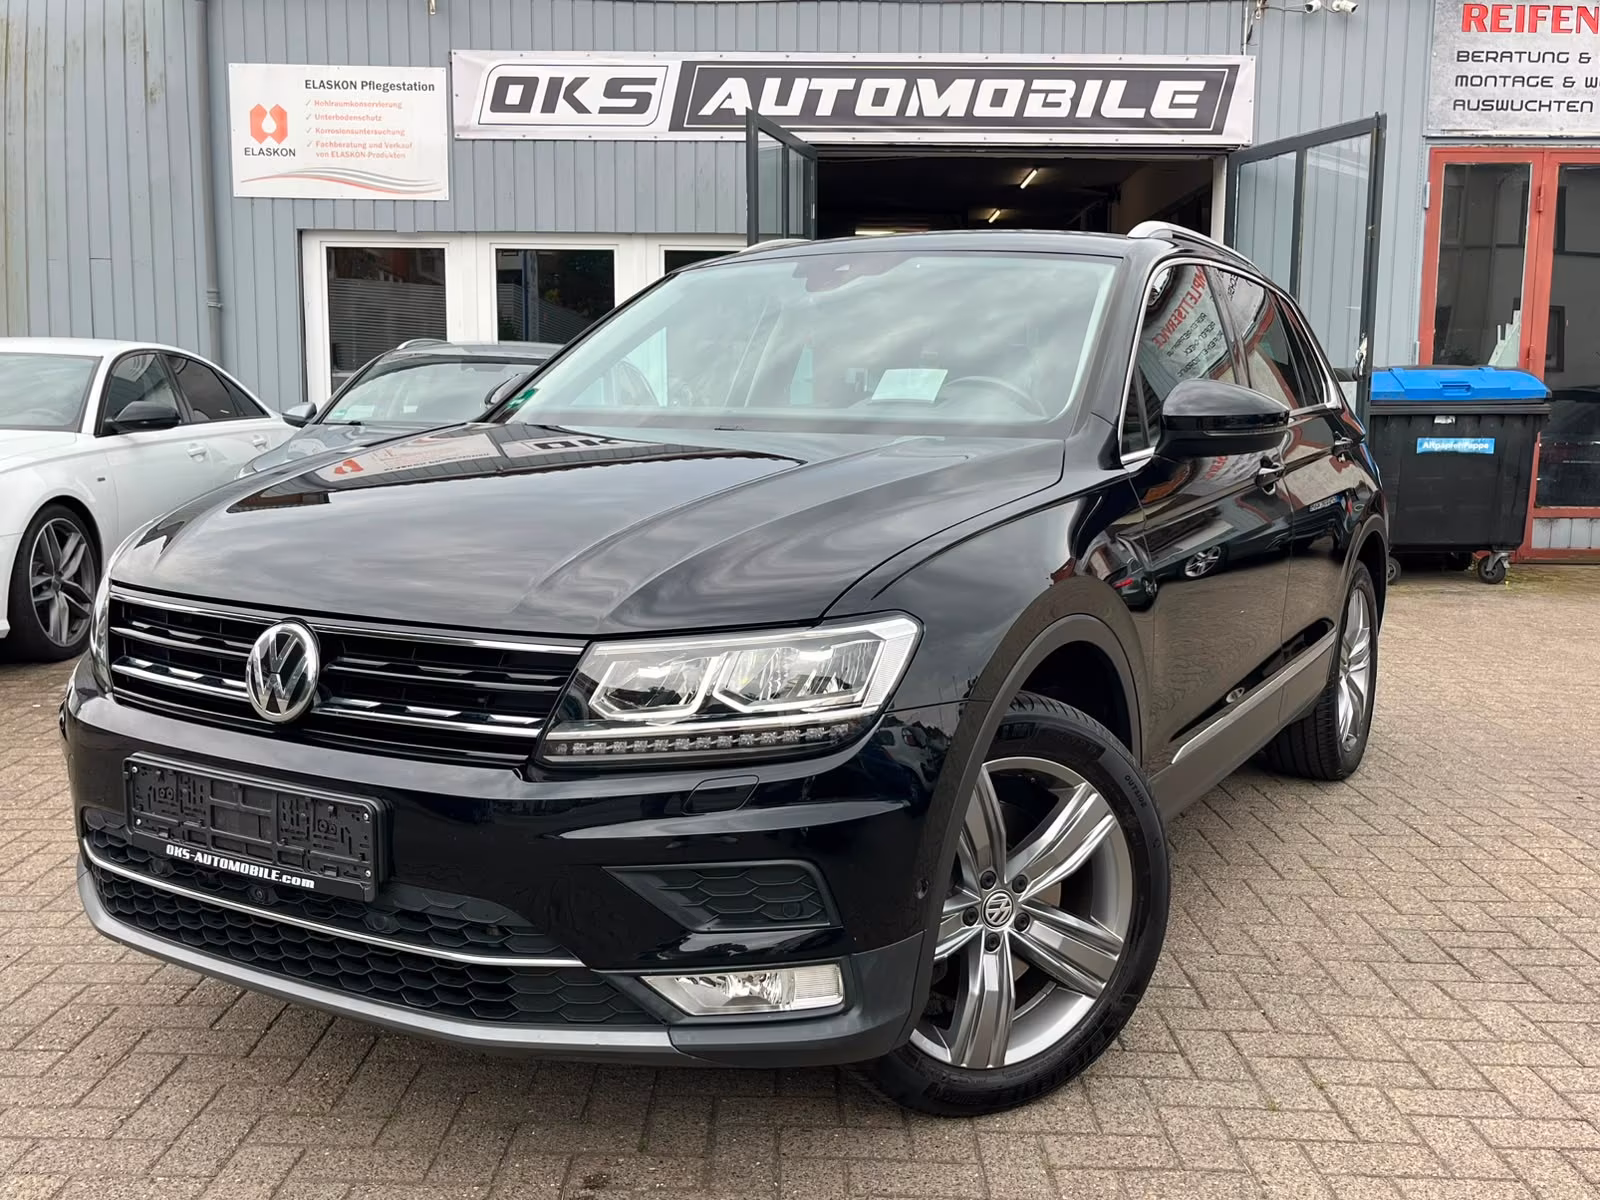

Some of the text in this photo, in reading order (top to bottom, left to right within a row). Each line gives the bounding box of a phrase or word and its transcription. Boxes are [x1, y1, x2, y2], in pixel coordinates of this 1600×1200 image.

[1461, 4, 1600, 34] REIFEN
[1456, 50, 1592, 63] BERATUNG &
[304, 79, 435, 93] ELASKON Pflegestation
[1455, 75, 1600, 88] MONTAGE & W
[490, 76, 1206, 119] OKS AUTOMOBILE
[314, 100, 403, 109] Hohlraumkonservierung
[1453, 99, 1594, 112] AUSWUCHTEN
[314, 113, 382, 121] Unterbodenschutz
[315, 127, 405, 136] Korrosionsuntersuchung
[315, 140, 367, 149] Fachberatung
[244, 147, 296, 157] ELASKON
[331, 151, 406, 159] ELASKON-Produkten
[1124, 774, 1147, 808] OUTSIDE
[165, 844, 315, 889] OKS-AUTOMOBILE.com
